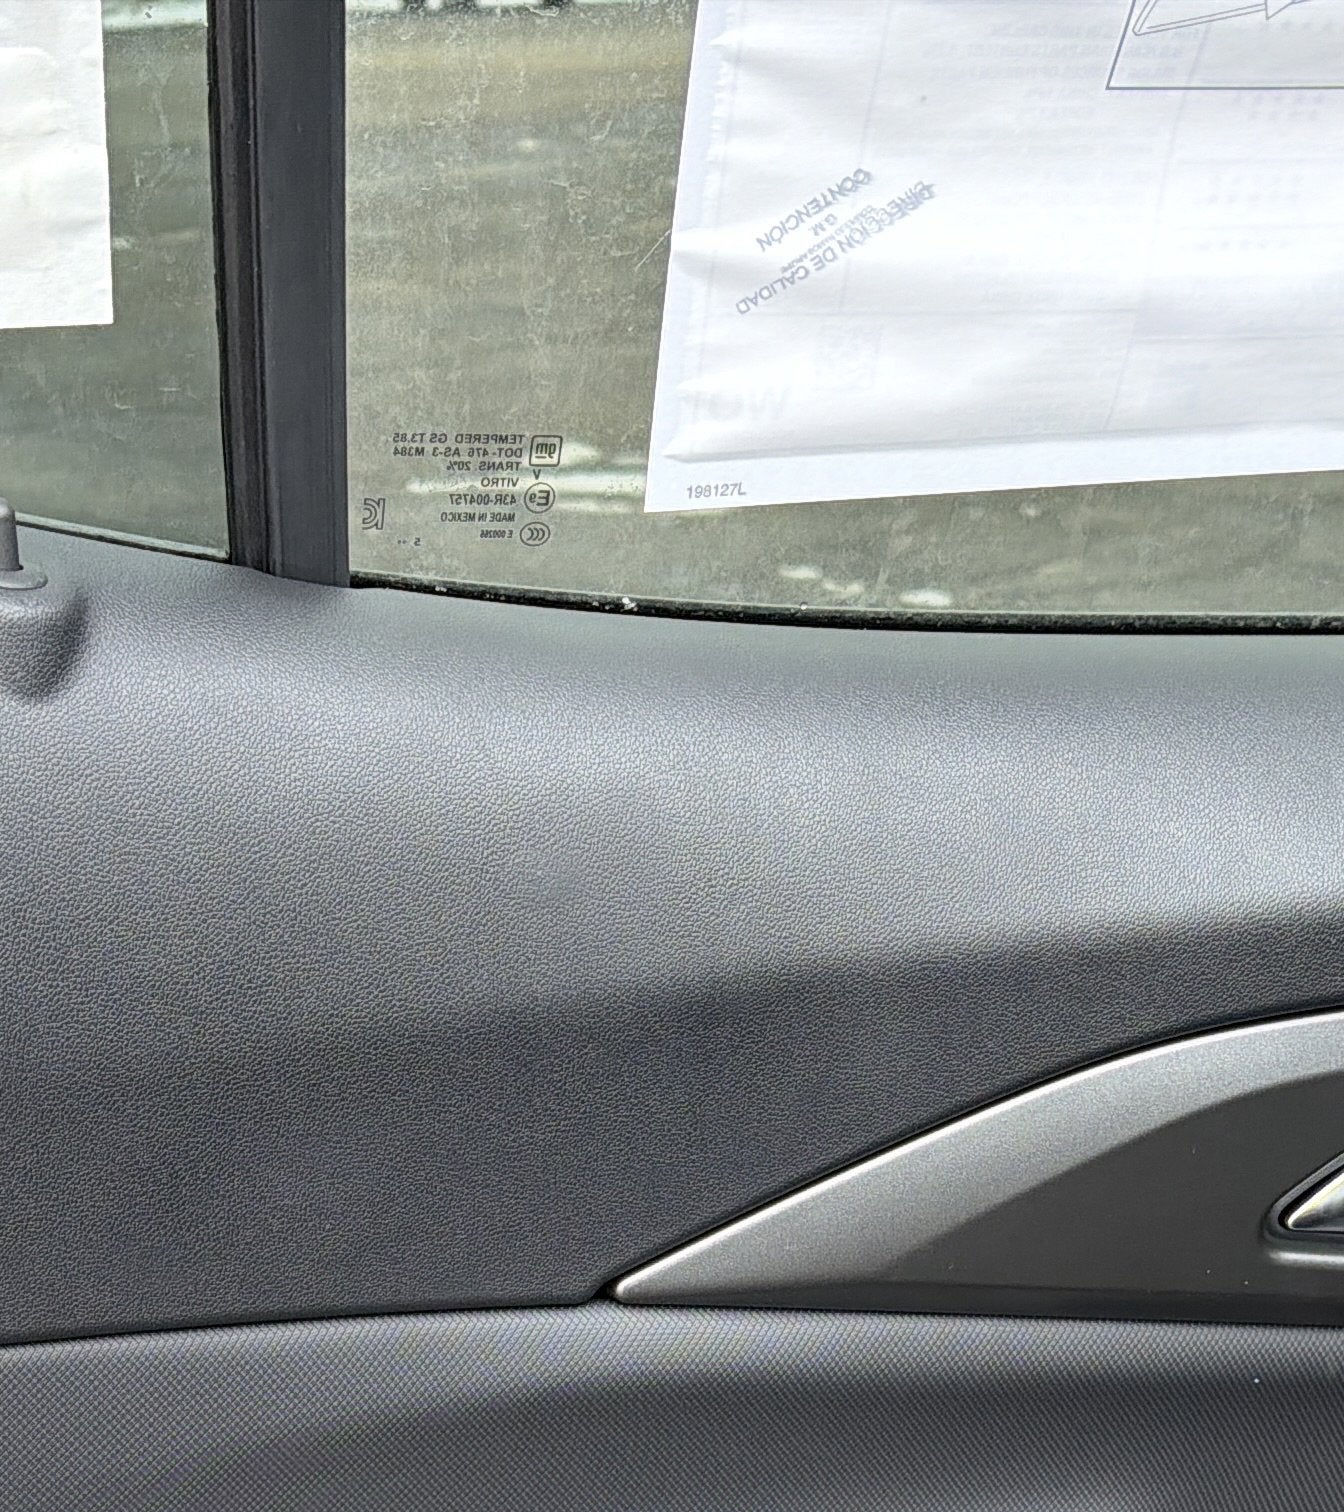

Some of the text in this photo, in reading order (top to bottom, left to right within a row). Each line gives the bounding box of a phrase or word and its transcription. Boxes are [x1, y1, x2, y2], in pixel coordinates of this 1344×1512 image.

[810, 246, 839, 272] DE
[736, 265, 810, 314] CALIDAD
[687, 482, 747, 499] 198127L
